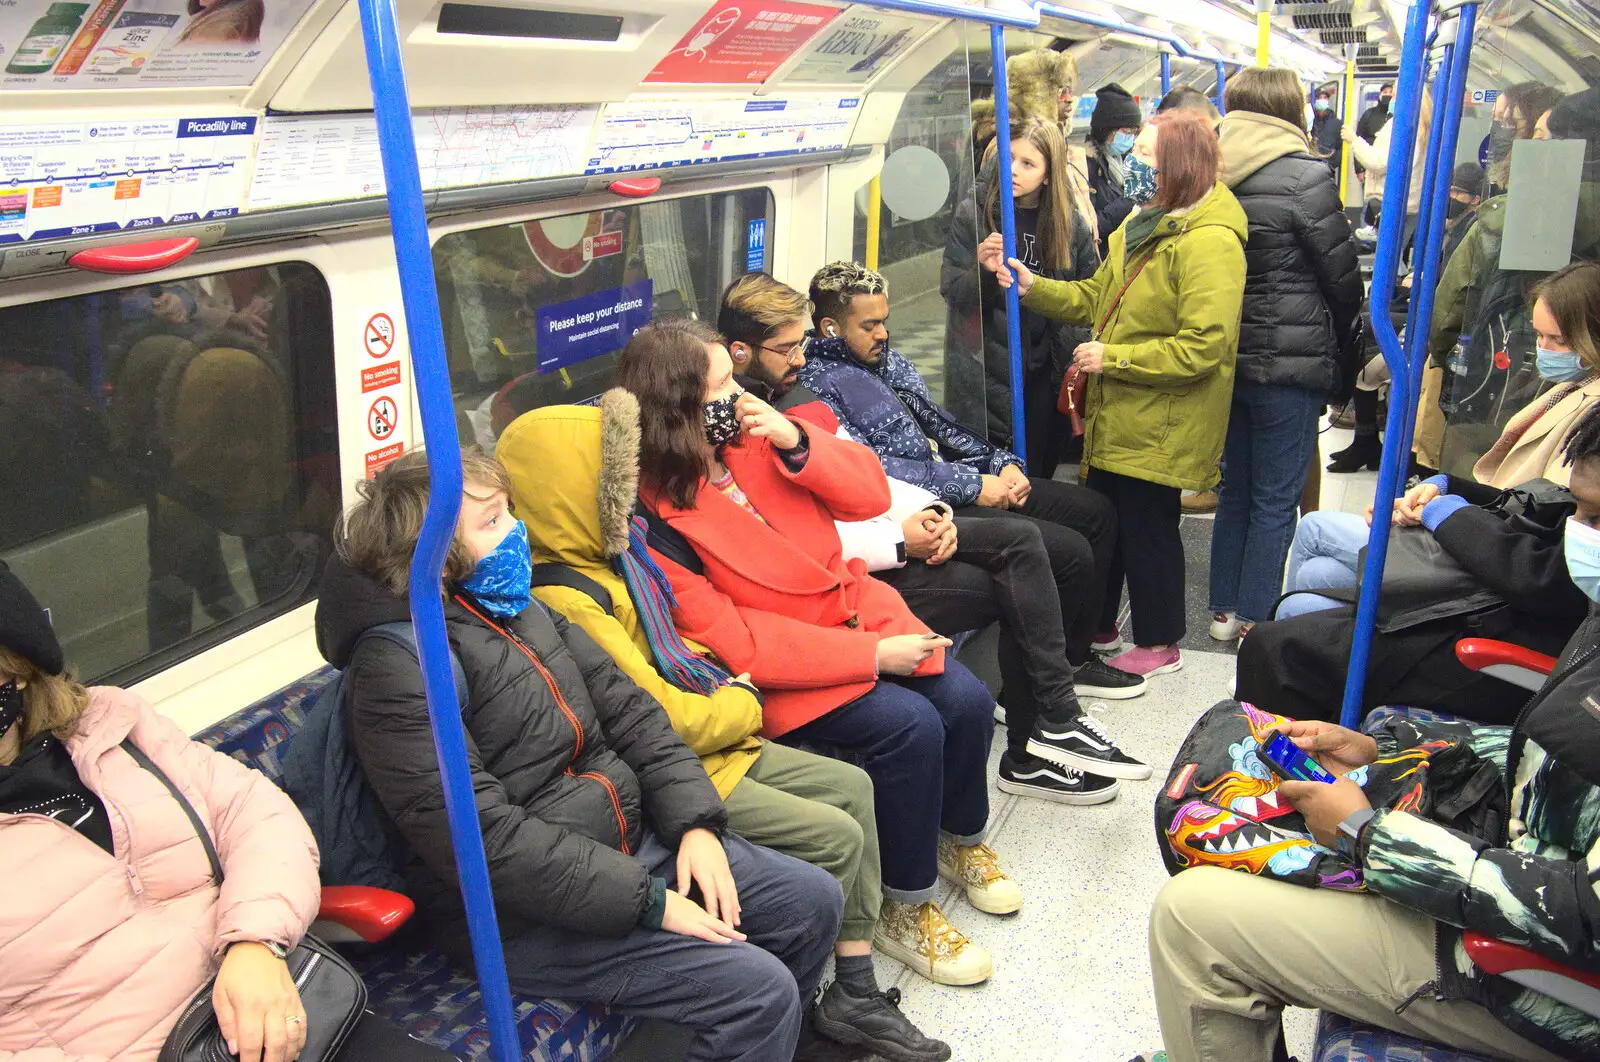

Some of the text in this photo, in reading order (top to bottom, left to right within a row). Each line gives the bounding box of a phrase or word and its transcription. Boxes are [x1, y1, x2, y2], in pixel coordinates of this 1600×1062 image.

[122, 33, 148, 42] Zinc
[187, 120, 247, 133] Piccadilly line
[133, 219, 148, 227] Zone
[205, 224, 225, 232] OPEN
[71, 226, 89, 234] Zone
[601, 238, 617, 247] smoking
[16, 248, 41, 258] CLOSE
[549, 298, 643, 333] Please keep your distance
[568, 322, 620, 343] Maintain social distancing
[364, 366, 399, 381] No smoking
[367, 445, 399, 462] No alcohol
